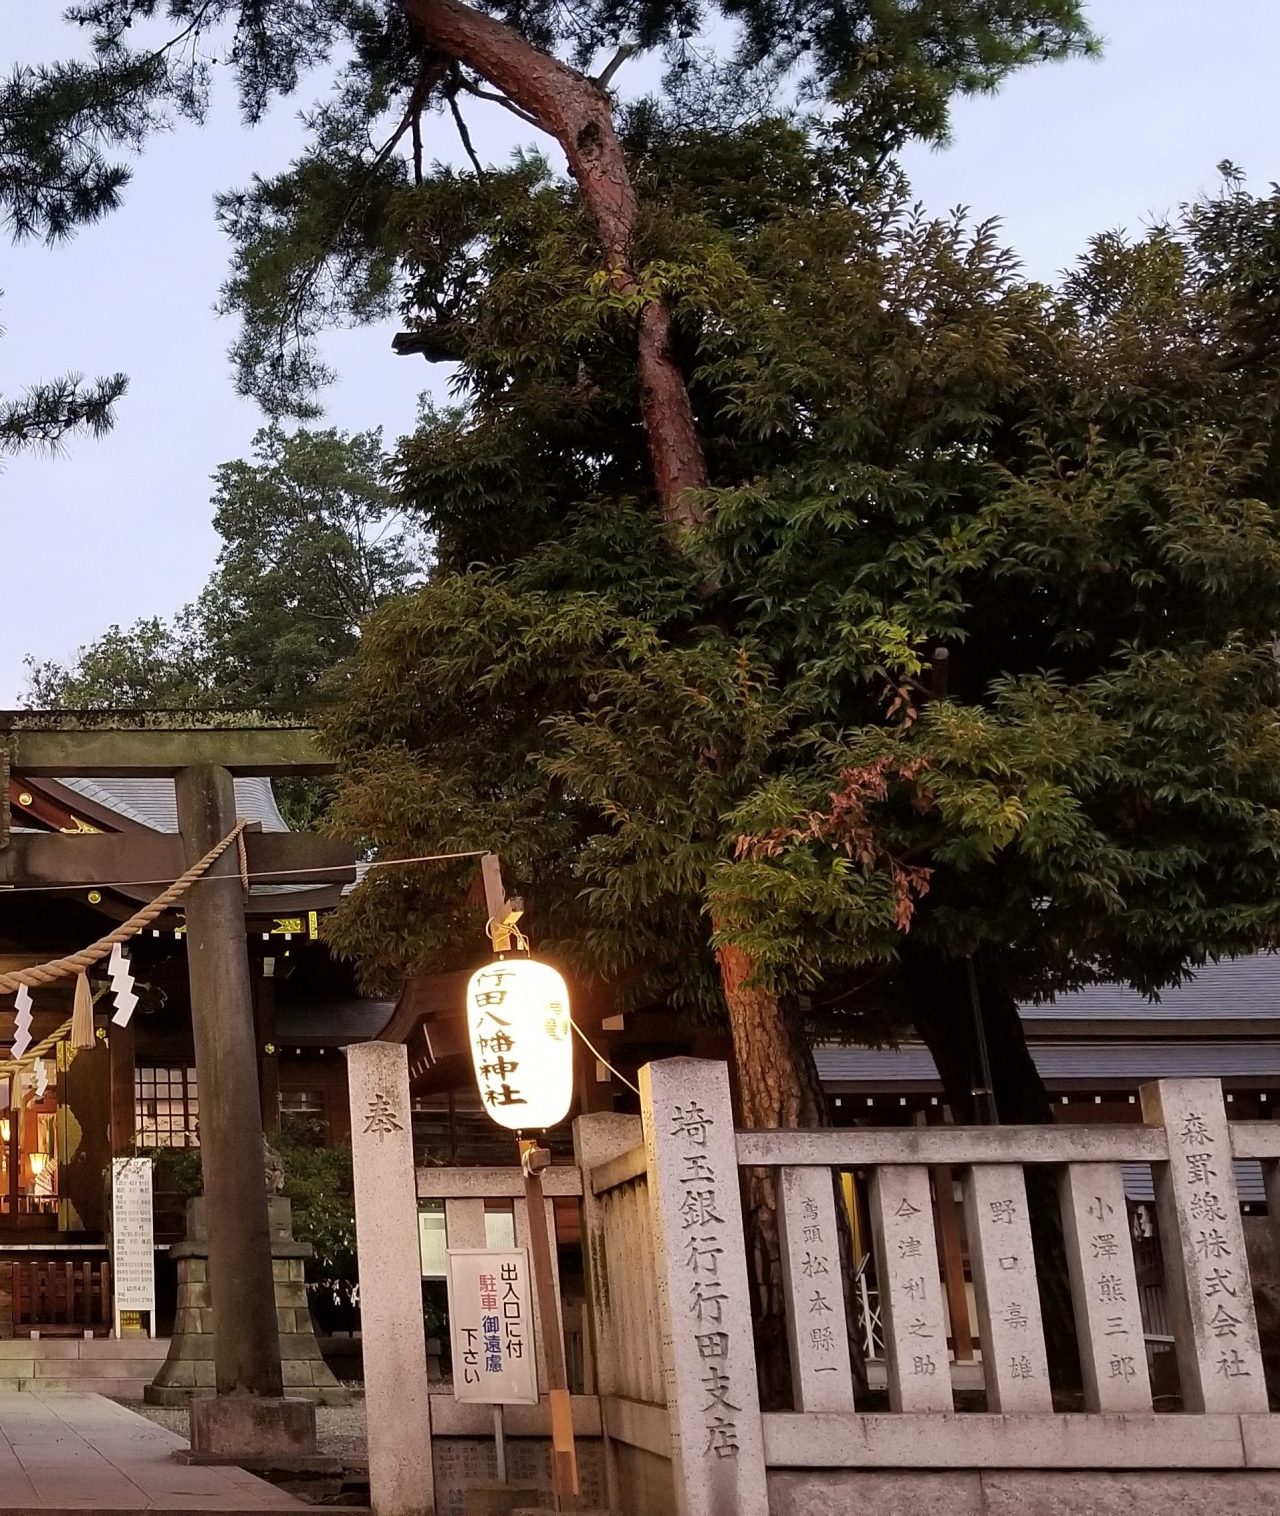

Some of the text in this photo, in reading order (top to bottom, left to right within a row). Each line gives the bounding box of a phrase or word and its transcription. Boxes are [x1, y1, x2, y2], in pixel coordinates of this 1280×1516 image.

[362, 1092, 404, 1141] 奉
[475, 969, 527, 1107] 行田八幡神社
[500, 1262, 524, 1358] 出入口に付
[669, 1099, 743, 1461] 埼玉銀行行田支店
[893, 1197, 937, 1377] 今津利之助
[989, 1198, 1036, 1381] 野口嘉雄
[1088, 1196, 1138, 1384] 小澤熊三郎
[1179, 1112, 1253, 1382] 森罫線株式会社
[459, 1327, 481, 1384] 下さい
